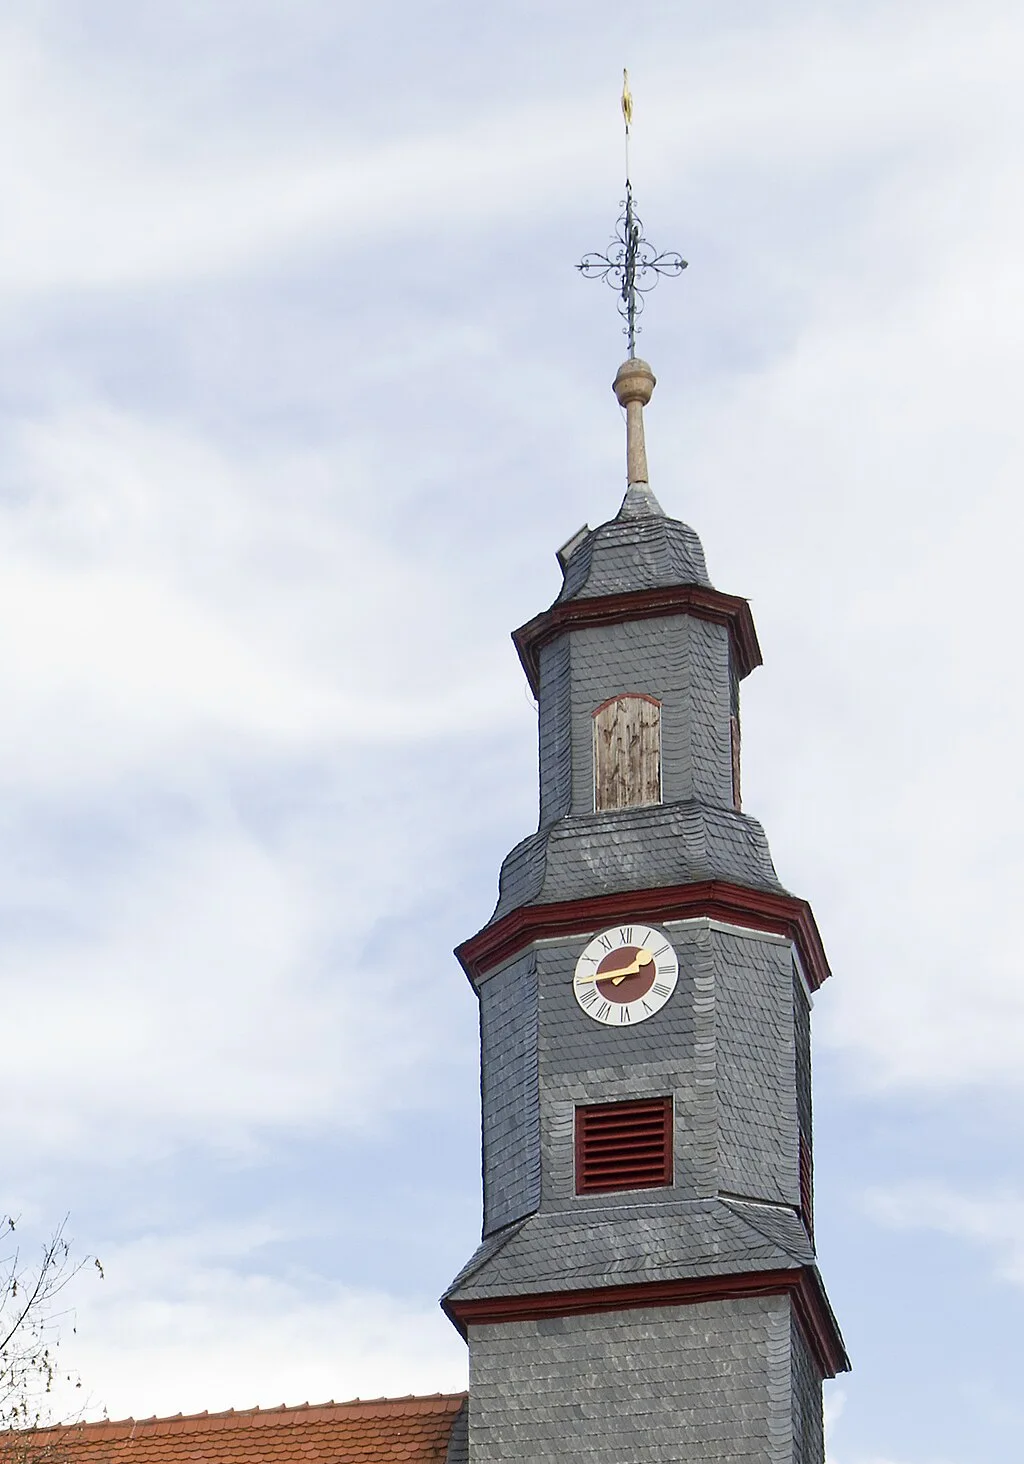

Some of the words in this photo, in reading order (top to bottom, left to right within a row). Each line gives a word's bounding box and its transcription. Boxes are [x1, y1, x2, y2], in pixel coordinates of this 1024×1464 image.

[598, 935, 613, 953] XI
[619, 927, 632, 945] XII
[581, 953, 599, 966] X
[653, 944, 670, 958] II
[658, 965, 676, 974] III
[579, 988, 599, 1009] VIII
[595, 1001, 612, 1020] VII
[620, 1005, 631, 1022] VI
